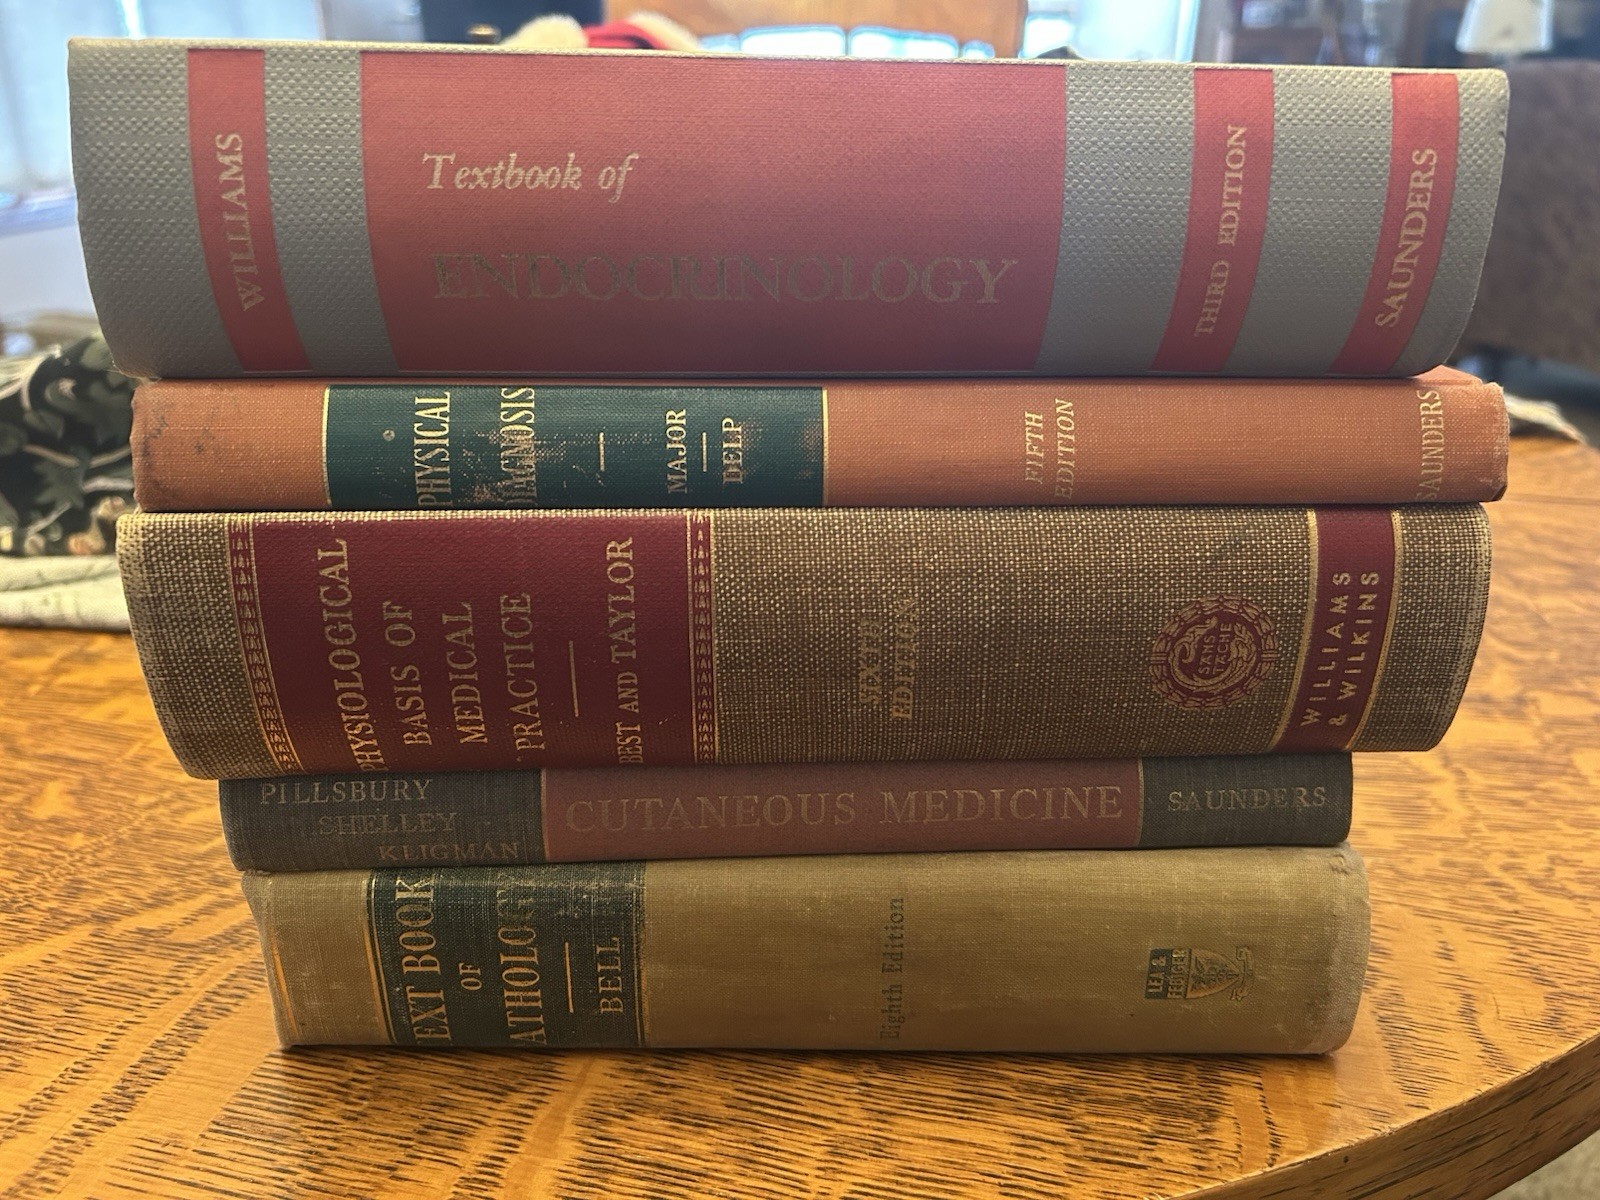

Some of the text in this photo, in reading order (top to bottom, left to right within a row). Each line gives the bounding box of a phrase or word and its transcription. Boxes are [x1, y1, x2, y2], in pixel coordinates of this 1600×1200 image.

[422, 151, 641, 204] Textbook of
[216, 132, 266, 311] WILLIAMS
[1194, 124, 1249, 338] THIRD EDITION
[1374, 147, 1438, 328] SAUNDERS
[430, 252, 1018, 305] ENDOCRINOLOGY
[413, 391, 454, 508] PHYSICAL
[665, 409, 688, 494] MAJOR
[721, 417, 743, 485] DELP
[1024, 411, 1044, 485] FIFTH
[1054, 398, 1075, 499] EDITION
[317, 537, 389, 772] PHYSIOLOGICAL
[383, 600, 432, 747] BASIS OF
[442, 602, 489, 746] MEDICAL
[500, 592, 546, 752] PRACTICE
[606, 537, 644, 766] BEST AND TAYLOR
[859, 618, 881, 705] SIXTH
[1198, 635, 1216, 675] SANS
[1300, 571, 1351, 726] WILLIAMS
[1328, 571, 1380, 726] & WILKINS
[260, 778, 433, 805] PILLSBURY
[318, 812, 458, 835] SHELLEY
[565, 785, 1124, 833] CUTANEOUS MEDICINE
[1167, 786, 1327, 813] SAUNDERS
[379, 841, 520, 861] KLIGMAN
[395, 873, 452, 1043] EXT BOOK
[458, 962, 483, 991] OF
[497, 873, 547, 1046] ATHOLOG
[595, 936, 626, 1015] BELL
[879, 898, 906, 1041] Eighth Edition
[1147, 955, 1167, 993] LEA &
[1167, 948, 1187, 999] FEBIGER
